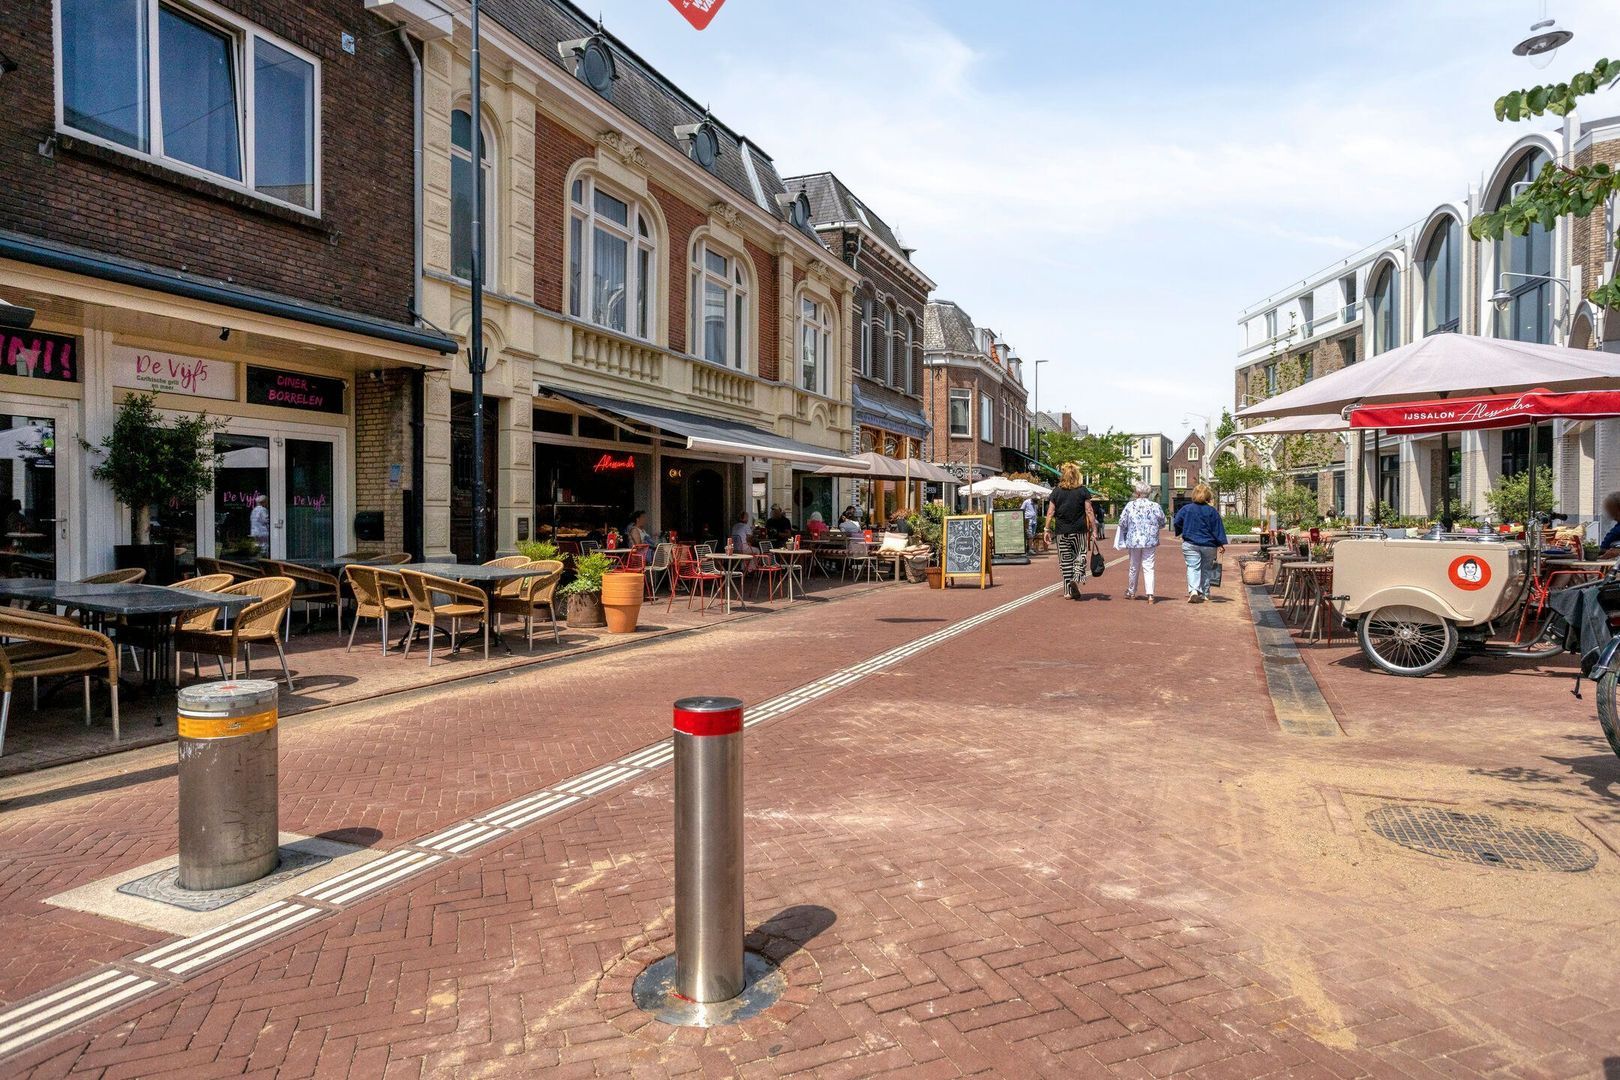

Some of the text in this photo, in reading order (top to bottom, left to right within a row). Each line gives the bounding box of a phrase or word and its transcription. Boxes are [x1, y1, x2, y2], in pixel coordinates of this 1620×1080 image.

[136, 355, 163, 374] De
[277, 375, 308, 391] DINER
[268, 389, 324, 406] BORRELEN
[1404, 399, 1534, 421] IJSSALON Alessandro
